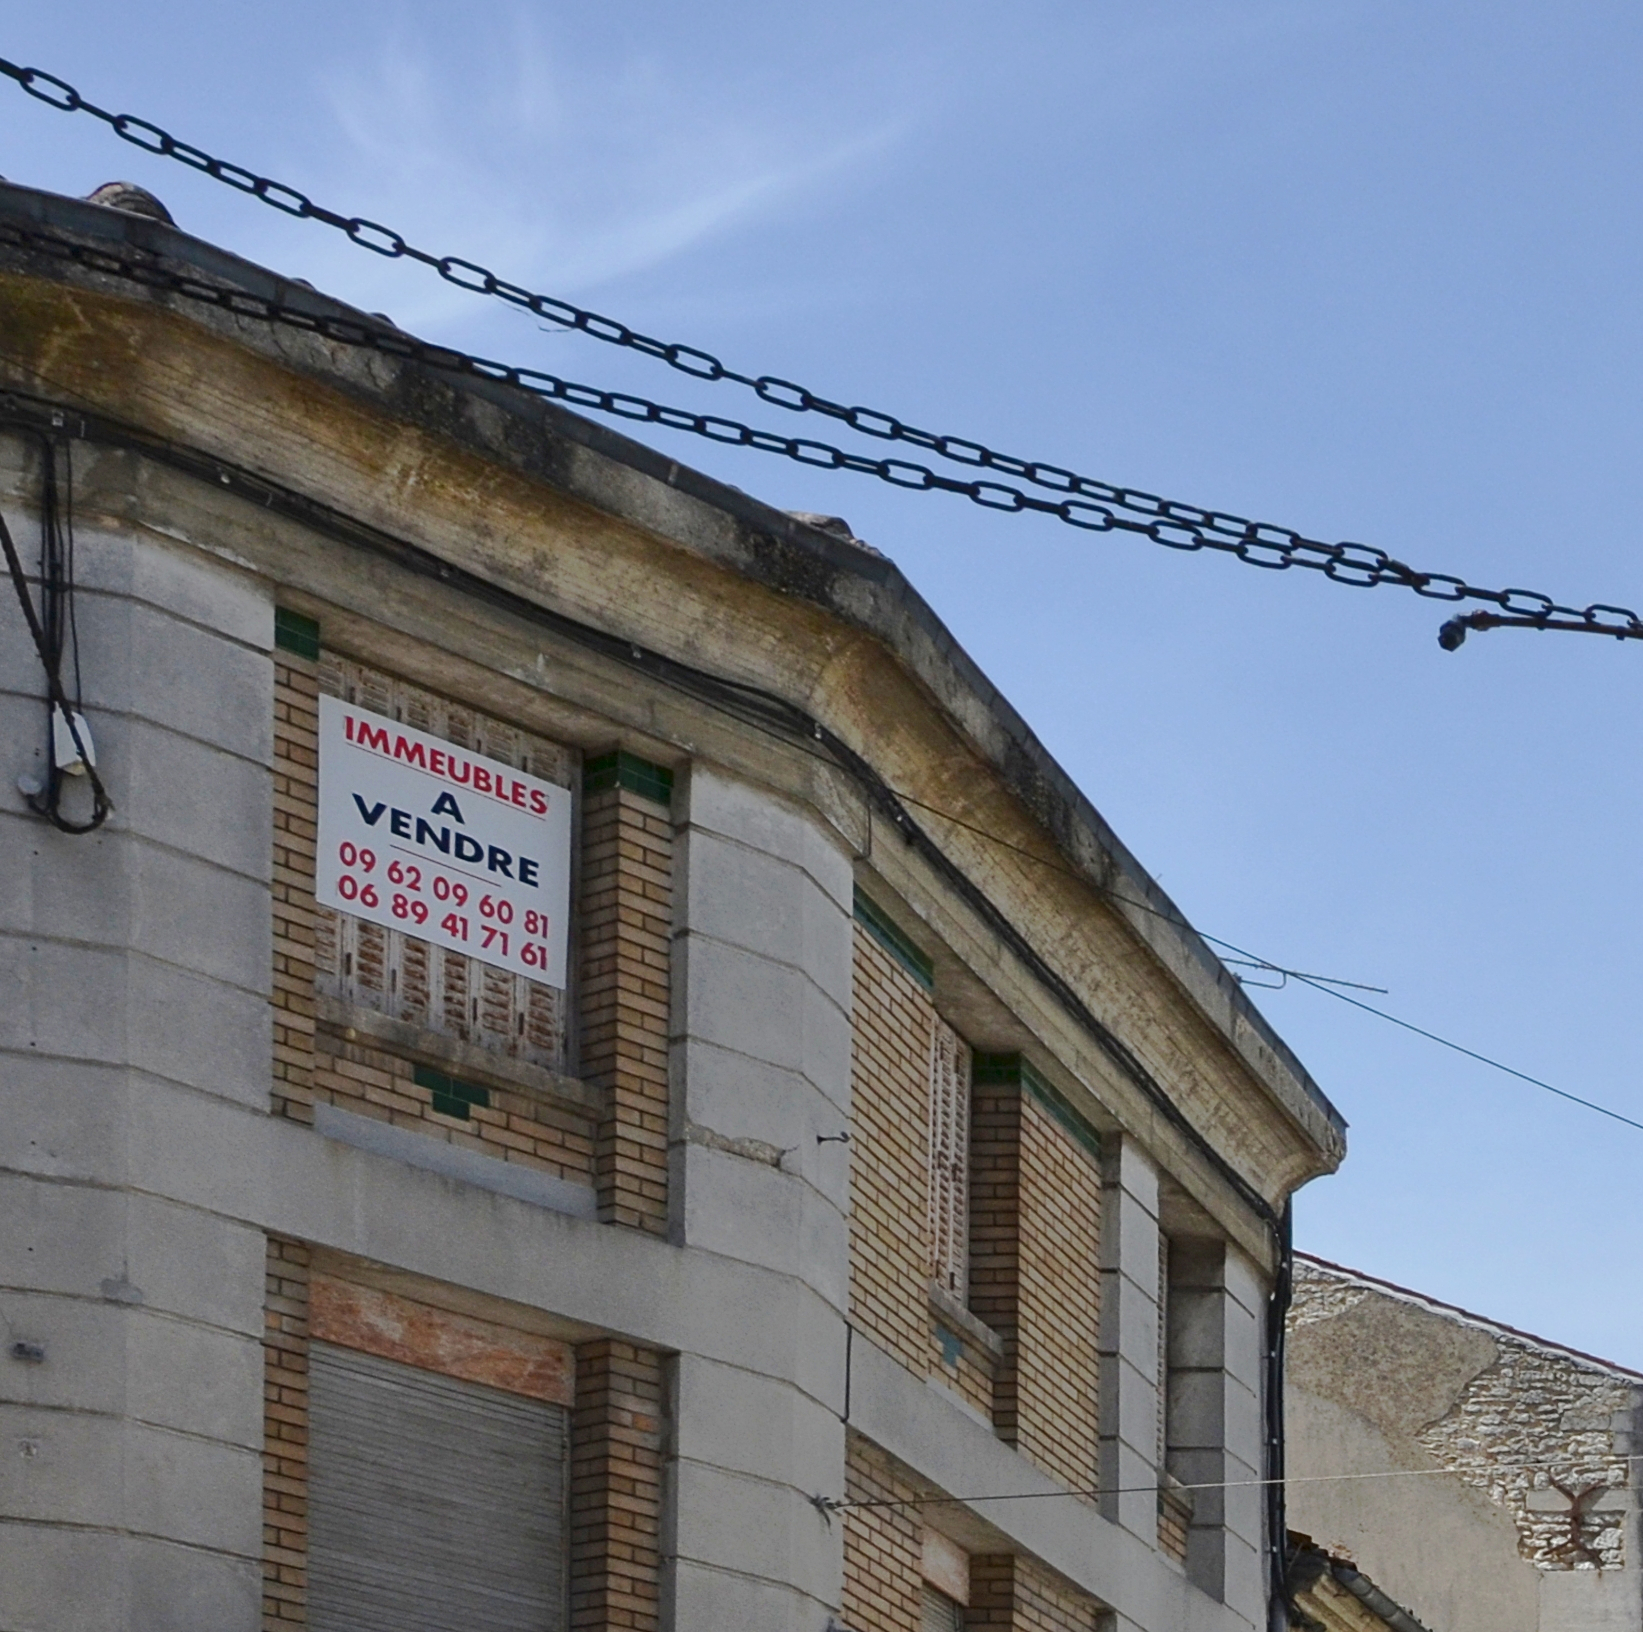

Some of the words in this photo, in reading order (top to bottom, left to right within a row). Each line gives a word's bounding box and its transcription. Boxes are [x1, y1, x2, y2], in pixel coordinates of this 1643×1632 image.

[344, 715, 549, 815] IMMEUBLES
[430, 791, 465, 825] A
[351, 792, 540, 889] VENDRE
[338, 874, 379, 910] 06
[391, 893, 429, 926] 89
[441, 912, 469, 942] 41
[480, 924, 510, 958] 71
[520, 941, 548, 971] 61
[339, 841, 376, 874] 09
[387, 860, 422, 892] 62
[433, 876, 469, 907] 09
[478, 893, 514, 925] 60
[525, 910, 549, 940] 81
